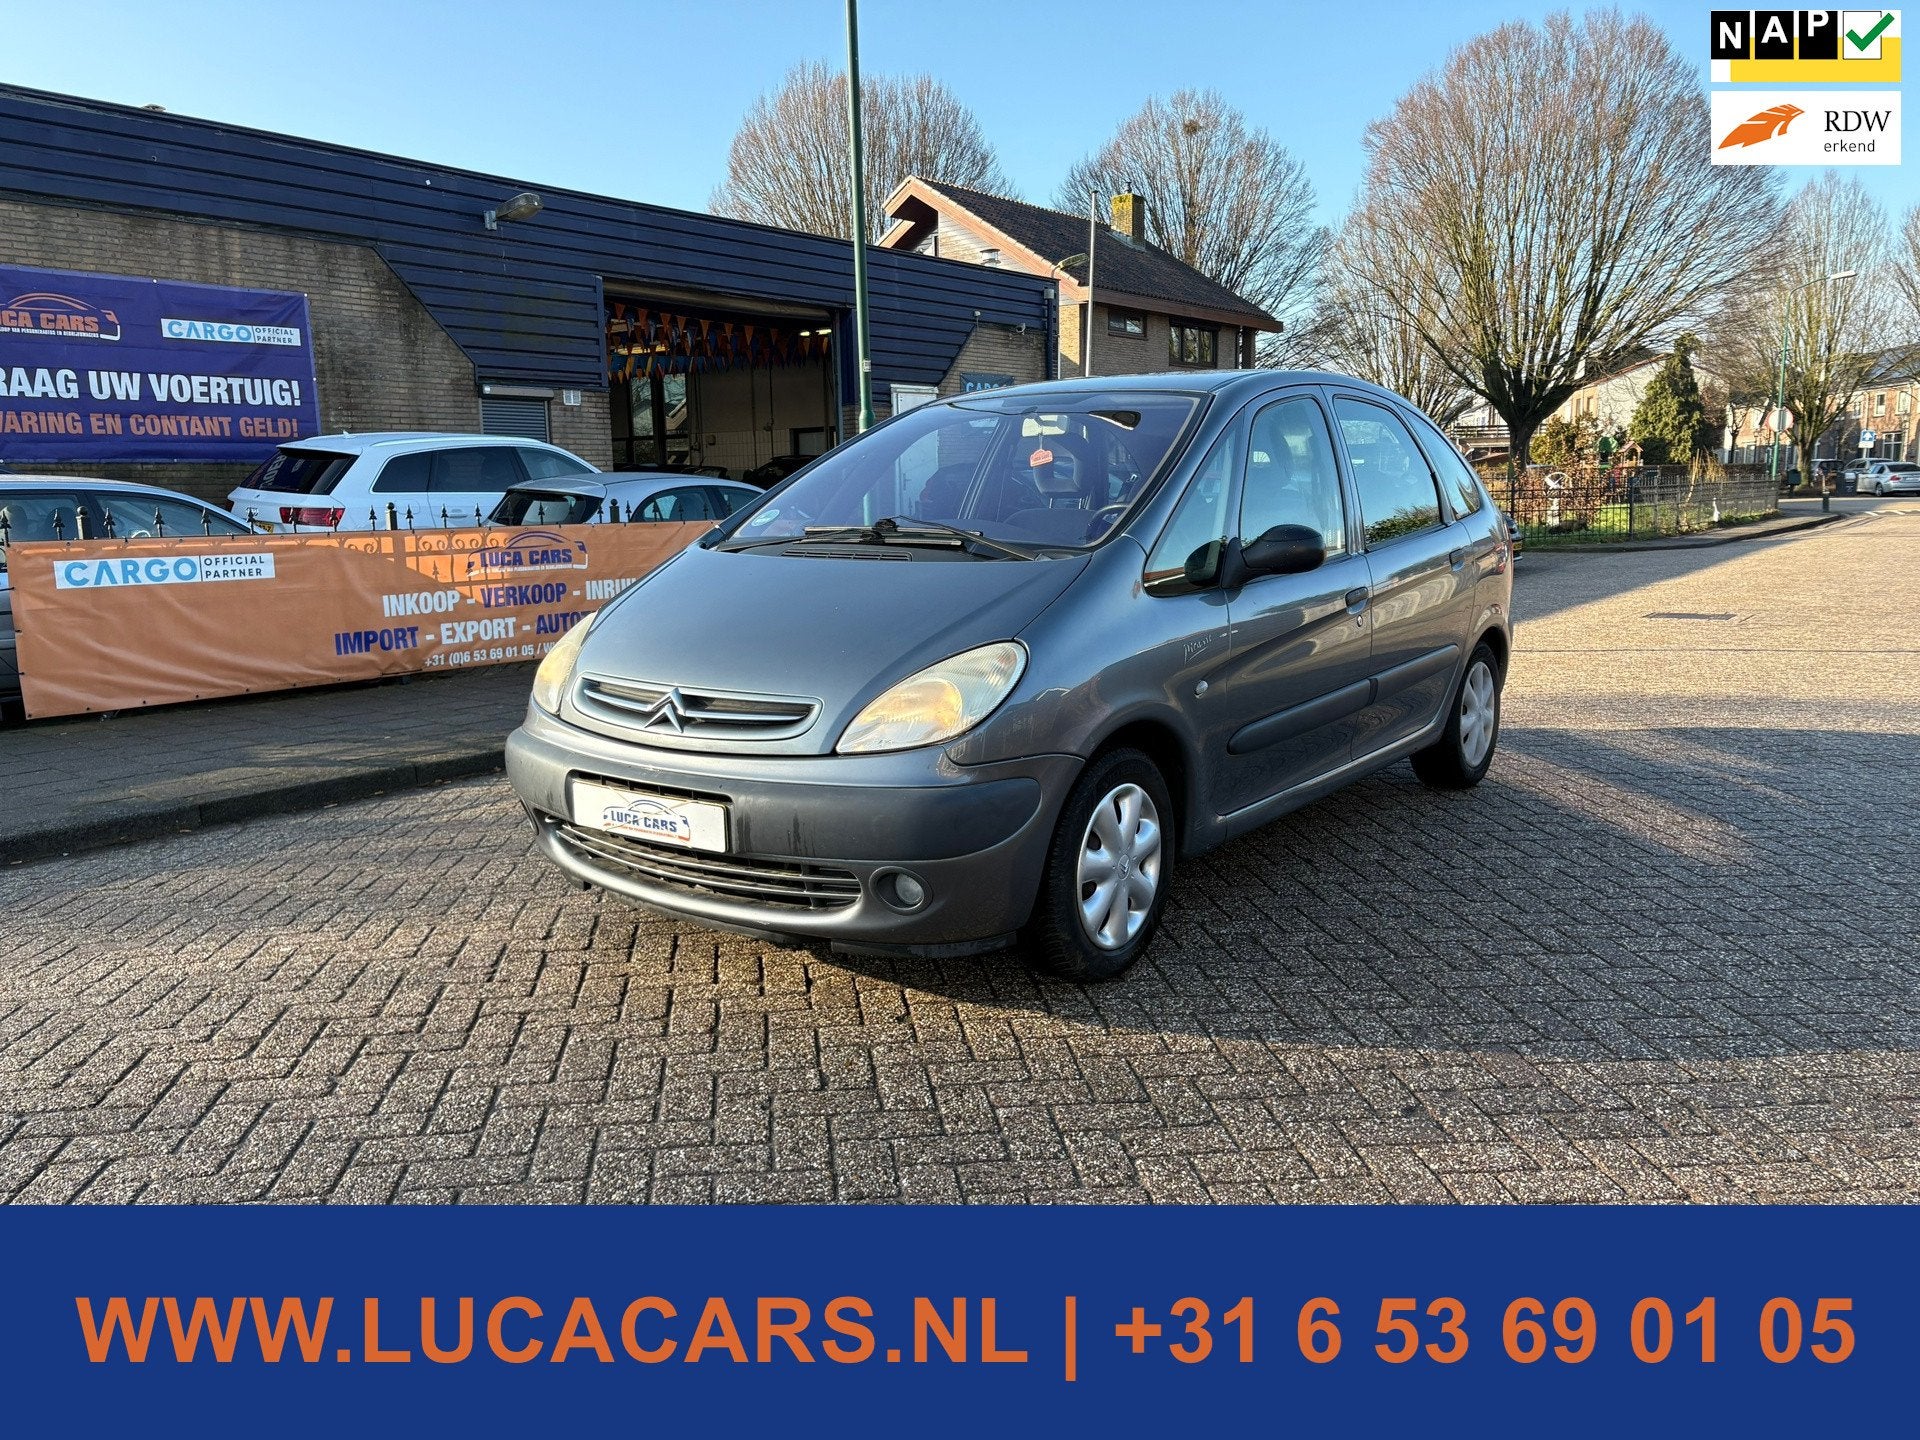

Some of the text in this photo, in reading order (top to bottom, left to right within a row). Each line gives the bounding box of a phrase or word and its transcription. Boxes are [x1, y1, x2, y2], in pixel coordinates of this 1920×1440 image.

[0, 310, 99, 332] CA CARS
[167, 320, 252, 341] CARGO
[255, 327, 294, 336] OFFICIAL
[256, 335, 293, 344] PARTNER
[88, 370, 141, 401] UW
[148, 373, 301, 406] VOERTUIG!
[0, 411, 299, 438] ARING EN CONTANT GELD!
[204, 555, 265, 566] OFFICIAL
[481, 549, 573, 568] LUCA CARS
[64, 558, 198, 587] CARGO
[205, 568, 263, 579] PARTNER
[382, 590, 461, 618] INKOOP
[480, 582, 567, 609] VERKOOP
[334, 626, 419, 656] IMPORT
[440, 617, 517, 645] EXPORT
[536, 610, 596, 635] AUTO
[425, 653, 445, 667] +31
[473, 649, 487, 661] 53
[489, 647, 503, 660] 69
[506, 646, 518, 657] 01
[521, 644, 534, 656] 05
[611, 810, 640, 827] LUCA
[643, 816, 678, 832] CARS
